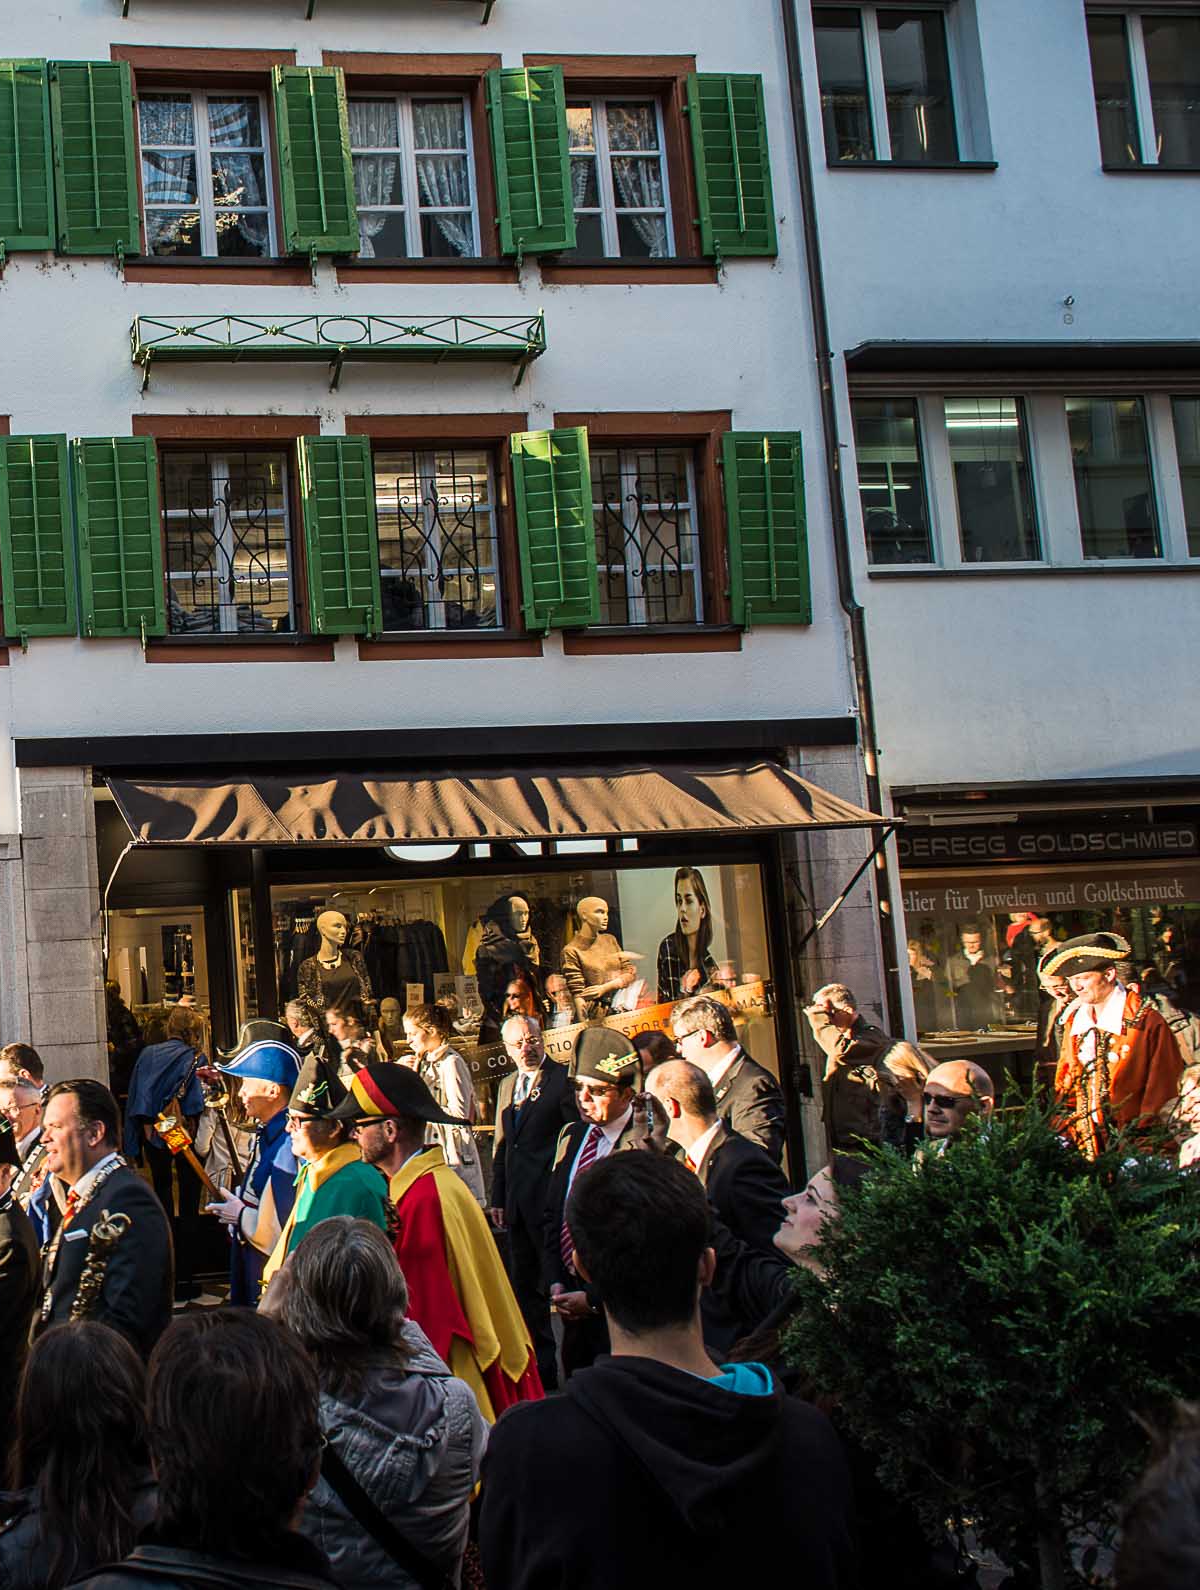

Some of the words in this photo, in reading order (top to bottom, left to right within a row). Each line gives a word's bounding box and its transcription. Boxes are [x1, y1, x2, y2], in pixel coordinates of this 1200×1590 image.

[1018, 830, 1195, 854] GOLDSCHMIED
[944, 888, 970, 911] für
[976, 886, 1038, 914] Juwelen
[1045, 884, 1076, 905] und
[1084, 880, 1186, 903] Goldschmuck
